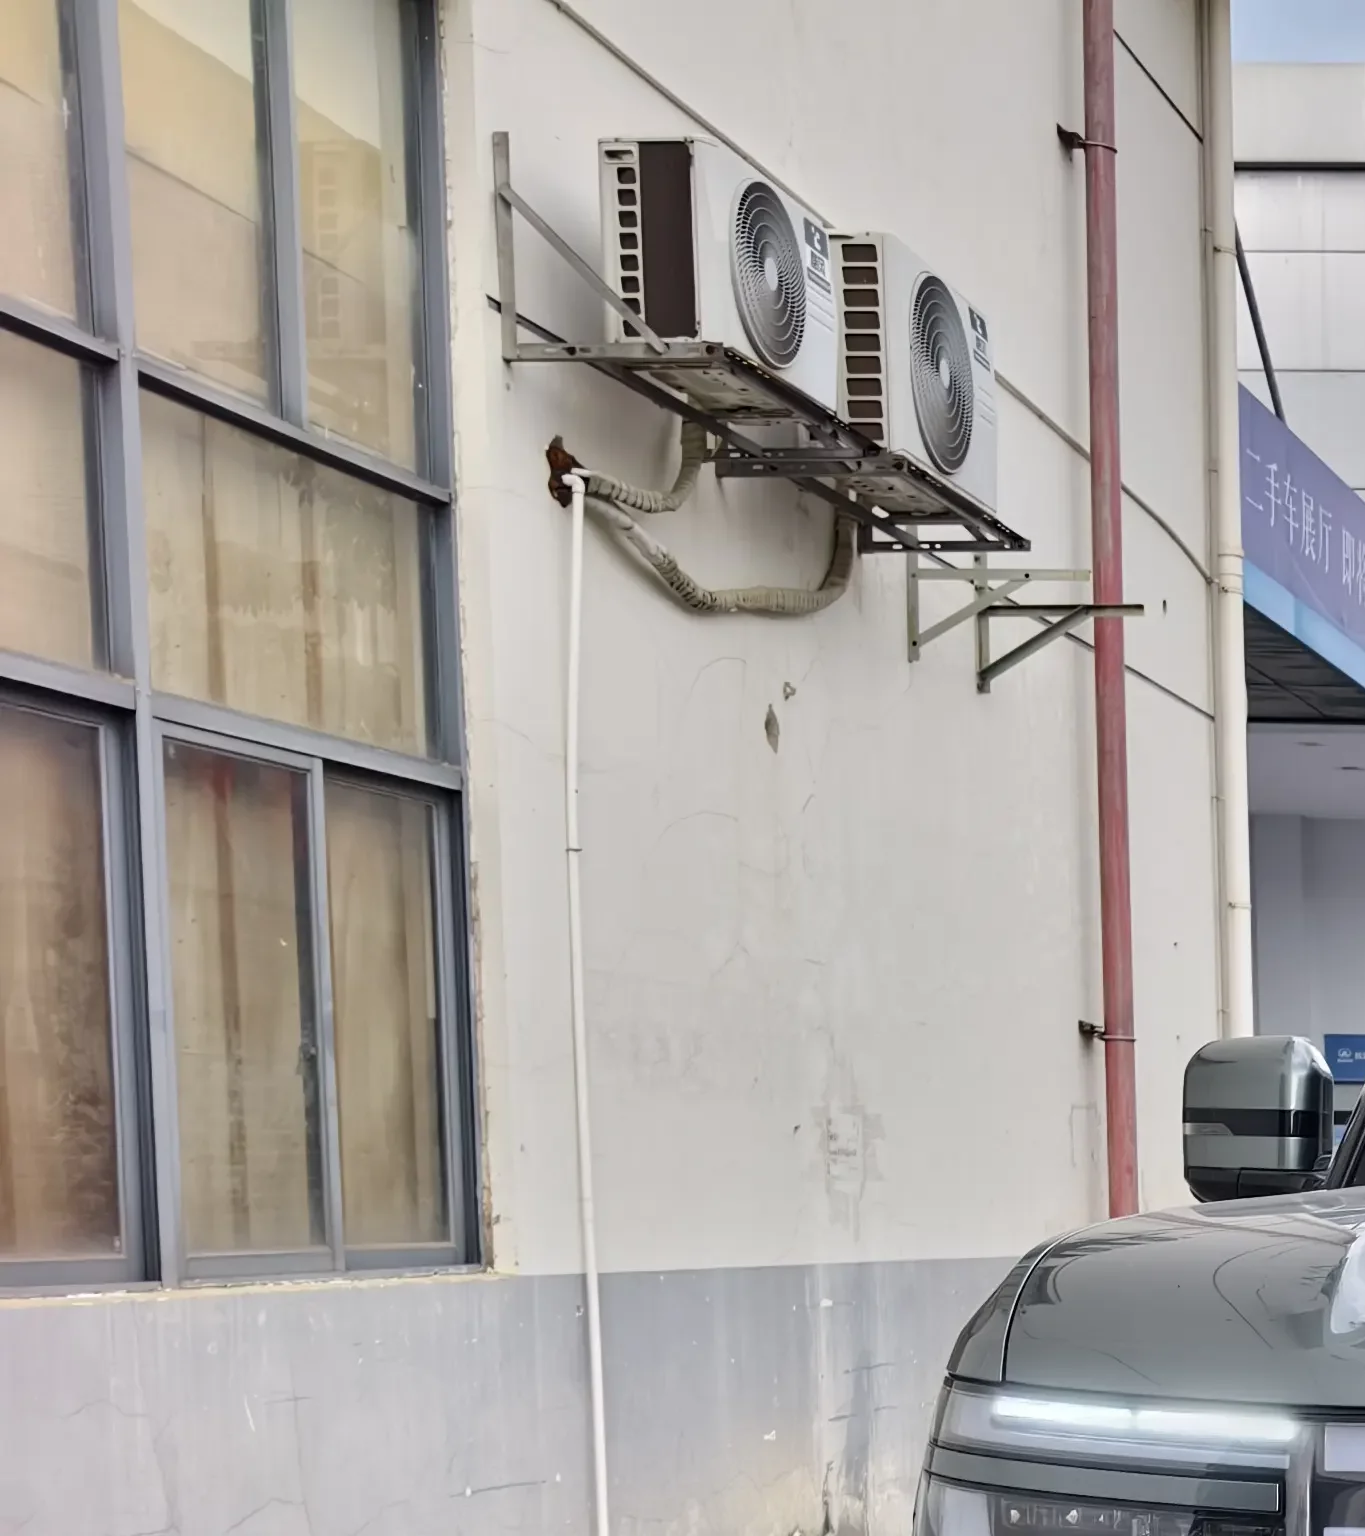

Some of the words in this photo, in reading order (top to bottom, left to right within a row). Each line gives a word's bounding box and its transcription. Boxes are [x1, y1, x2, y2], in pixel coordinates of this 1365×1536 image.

[1245, 447, 1332, 574] 二手车展厅
